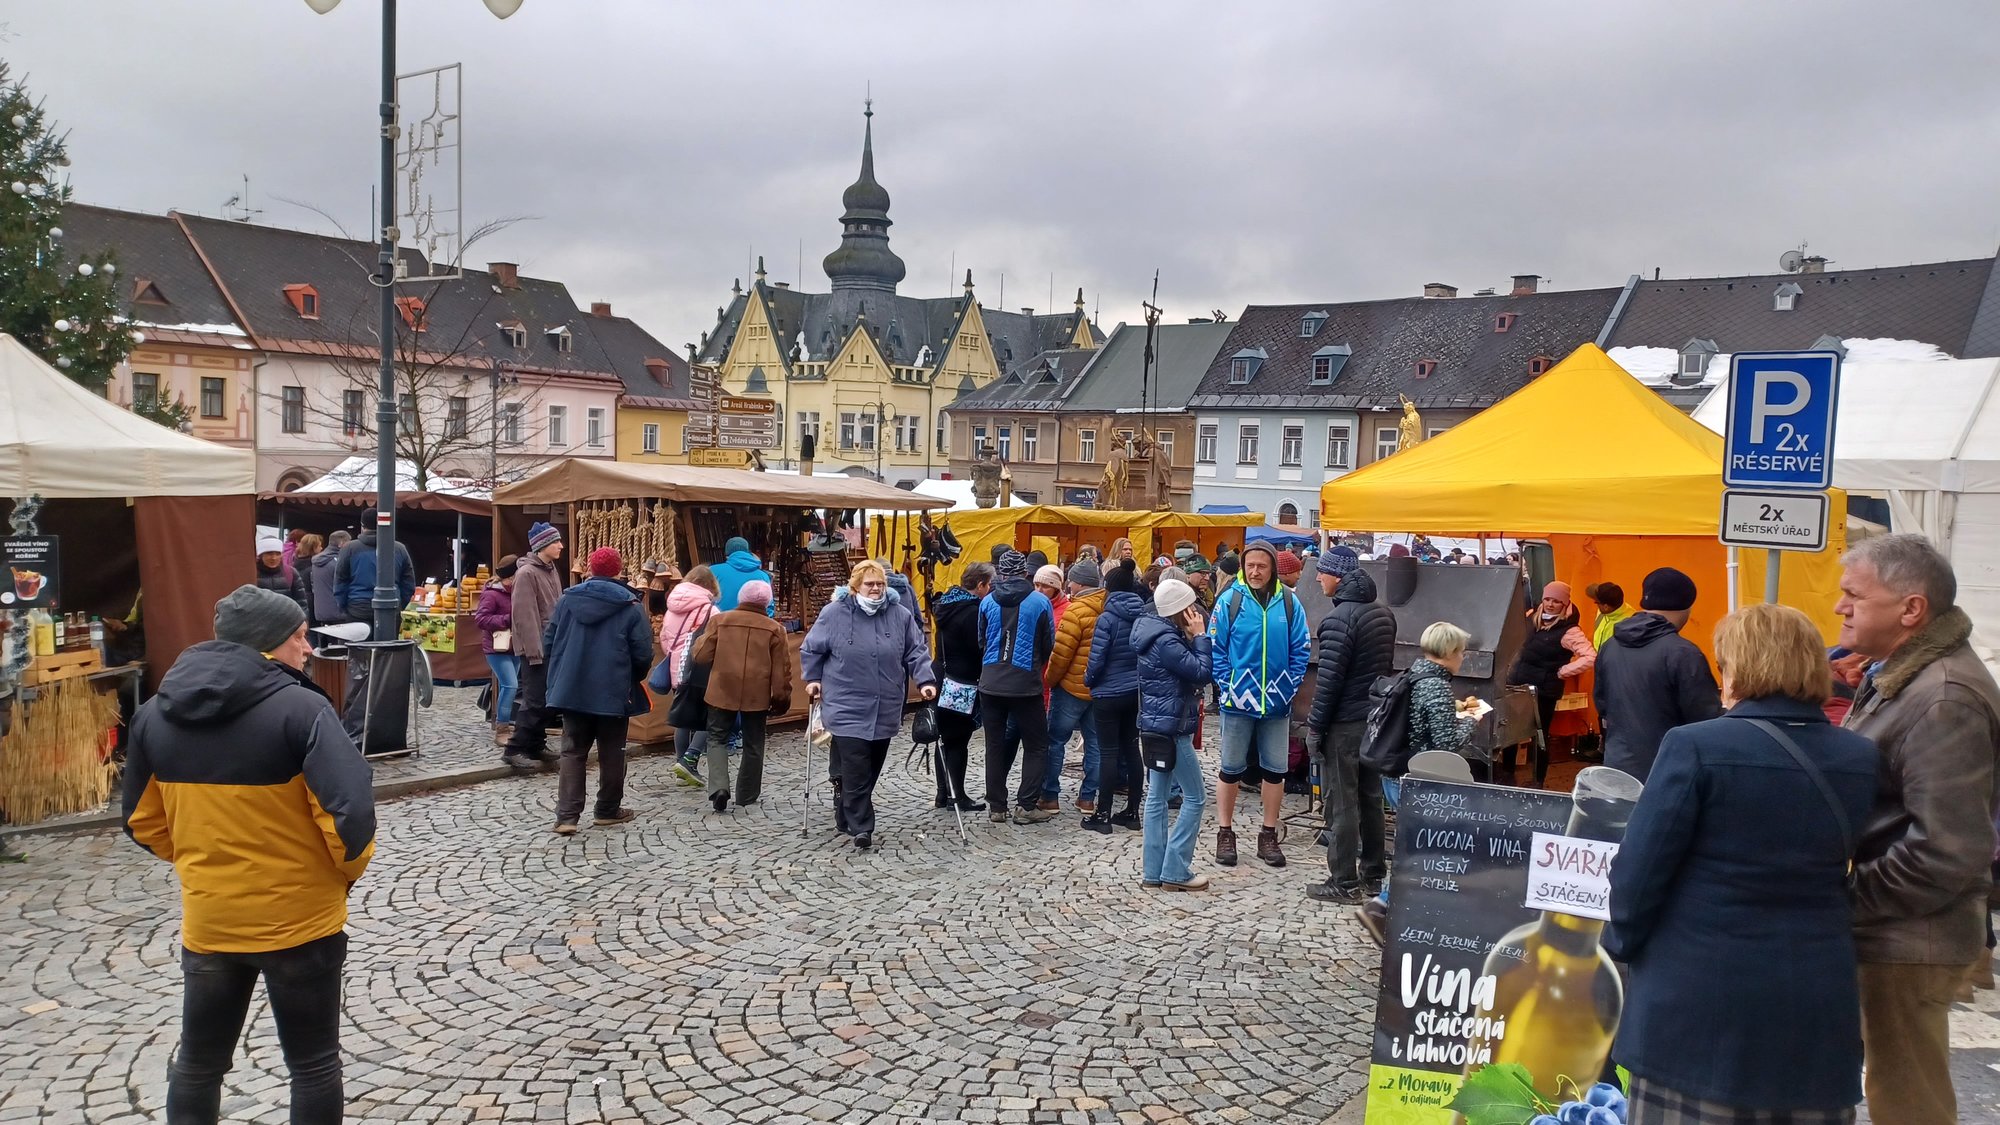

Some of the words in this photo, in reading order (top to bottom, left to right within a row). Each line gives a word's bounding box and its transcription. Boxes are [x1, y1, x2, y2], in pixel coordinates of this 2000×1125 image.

[1749, 370, 1812, 444] P
[1775, 422, 1810, 452] 2x
[1732, 451, 1823, 472] RÉSERVÉ
[1759, 503, 1785, 522] 2x
[1733, 522, 1780, 536] MĚSTSKÝ
[1782, 523, 1811, 537] ÚŘAD
[1489, 829, 1526, 860] VÍNA
[1423, 855, 1470, 875] VIŠEŇ
[1536, 841, 1614, 879] SVAŘÁ
[1535, 881, 1608, 906] STÁČENÝ
[1400, 926, 1437, 941] LETNÍ
[1439, 934, 1481, 949] PERLIVÉ
[1484, 941, 1529, 958] KOTEJLY
[1400, 952, 1497, 1013] Vína
[1414, 1008, 1506, 1040] stáčená
[1391, 1036, 1402, 1059] i
[1406, 1034, 1492, 1066] lahvová
[1398, 1072, 1452, 1096] Moravy
[1400, 1093, 1408, 1105] aj
